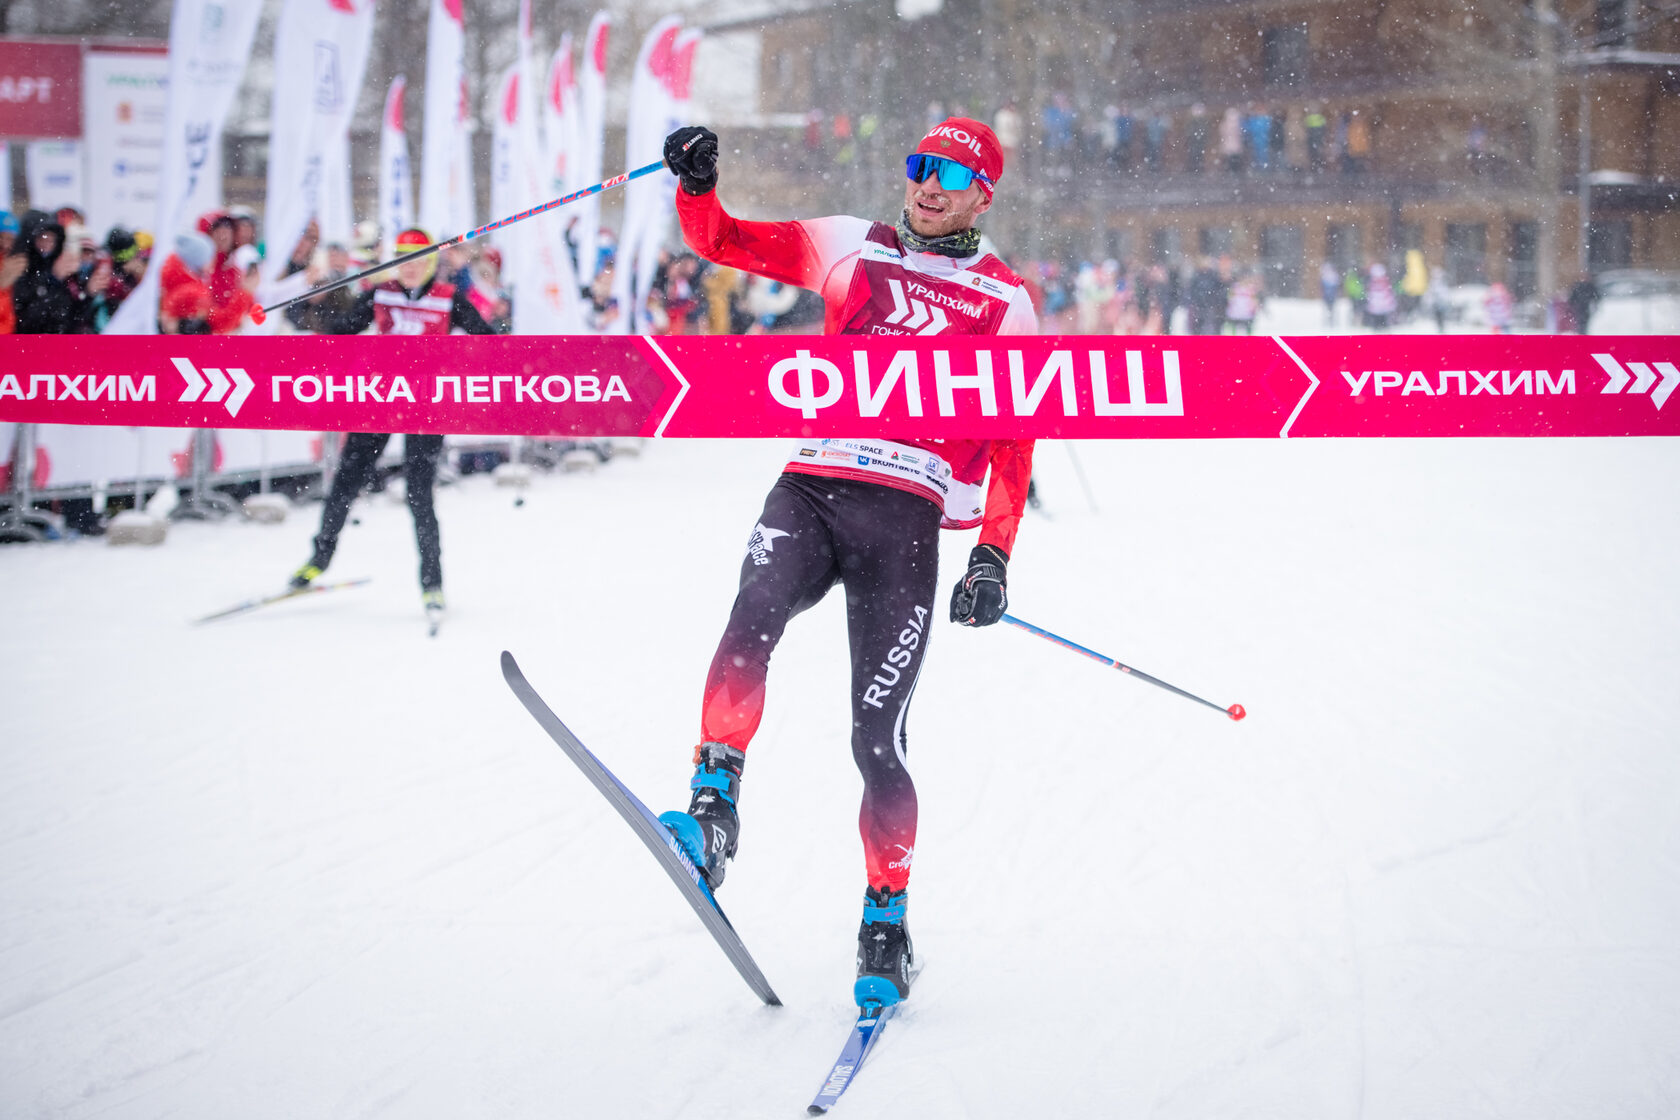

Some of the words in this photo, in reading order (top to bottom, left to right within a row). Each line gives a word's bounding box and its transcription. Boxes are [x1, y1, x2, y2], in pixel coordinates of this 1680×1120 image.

[906, 281, 983, 319] УРАЛХИМ
[271, 375, 417, 403] ГОНКА
[431, 375, 633, 403] ЛЕГКОВА
[767, 349, 1185, 419] ФИНИШ
[1341, 369, 1576, 397] УРАЛХИМ
[862, 604, 929, 709] RUSSIA
